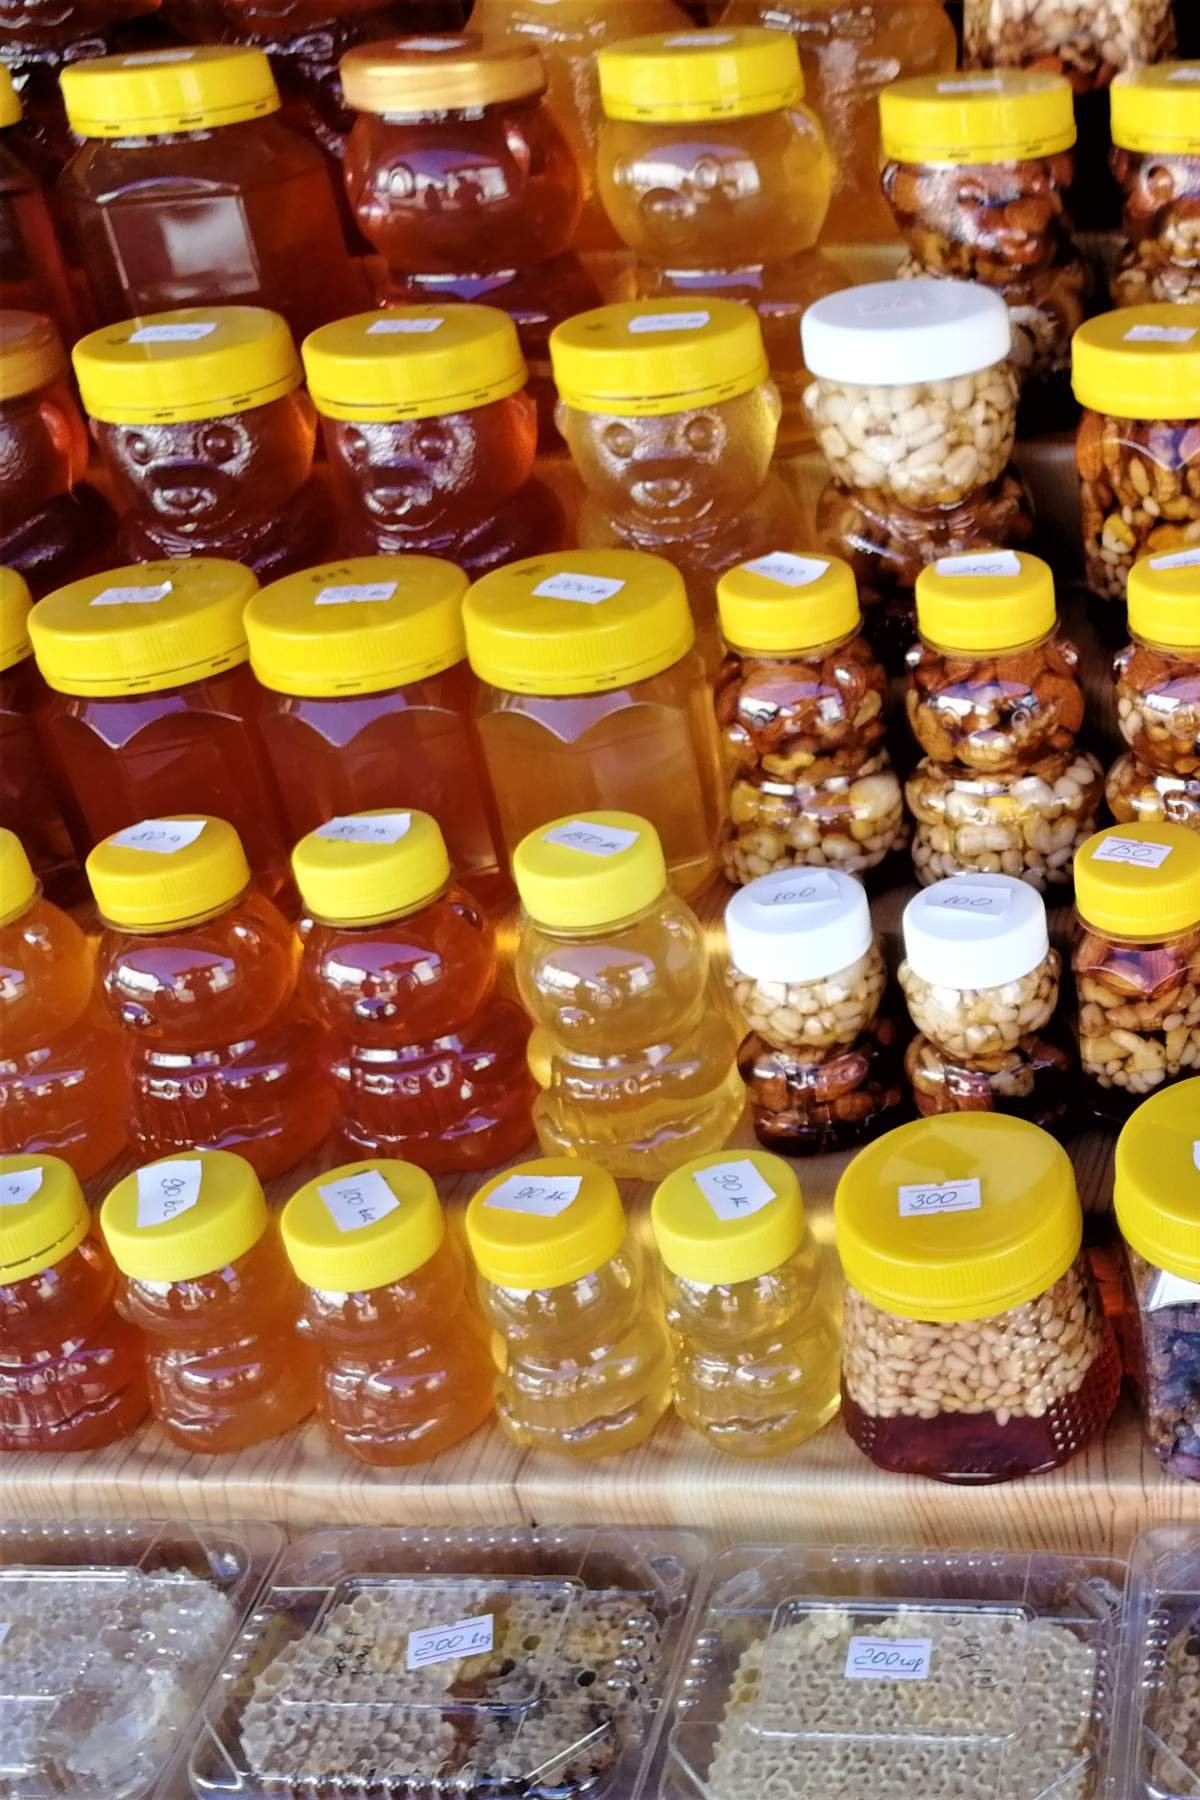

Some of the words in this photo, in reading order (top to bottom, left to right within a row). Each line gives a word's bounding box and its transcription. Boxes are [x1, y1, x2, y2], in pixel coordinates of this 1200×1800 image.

[1107, 843, 1153, 857] 150
[772, 887, 816, 902] 100
[942, 894, 992, 906] 100
[161, 1178, 186, 1197] 90
[713, 1174, 743, 1192] 90
[513, 1186, 546, 1200] 90
[910, 1191, 958, 1209] 300
[414, 1635, 464, 1657] 200
[854, 1648, 898, 1666] 200
